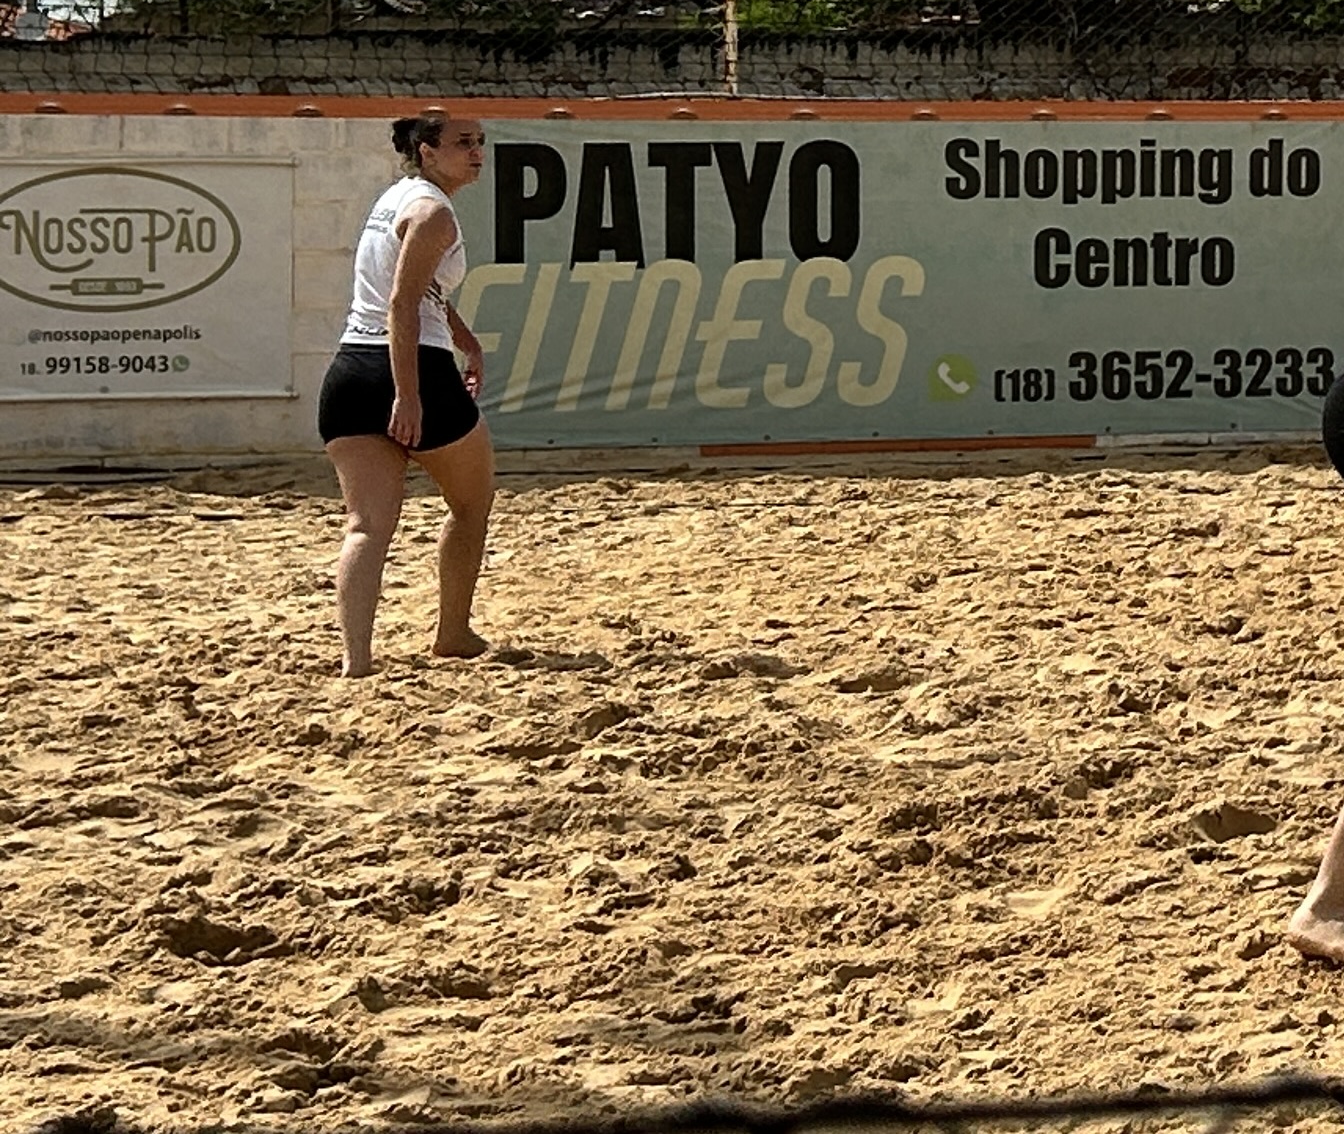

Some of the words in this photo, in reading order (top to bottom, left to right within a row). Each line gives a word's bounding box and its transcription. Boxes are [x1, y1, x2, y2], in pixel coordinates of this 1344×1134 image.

[943, 137, 1233, 205] Shopping
[1248, 138, 1321, 198] do
[494, 139, 861, 270] PATYO
[1033, 227, 1235, 289] Centro
[27, 325, 202, 345] @nossopaopenapolis
[45, 355, 169, 375] 99158-9043
[993, 368, 1056, 402] (18)
[1068, 347, 1335, 400] 3652-3233
